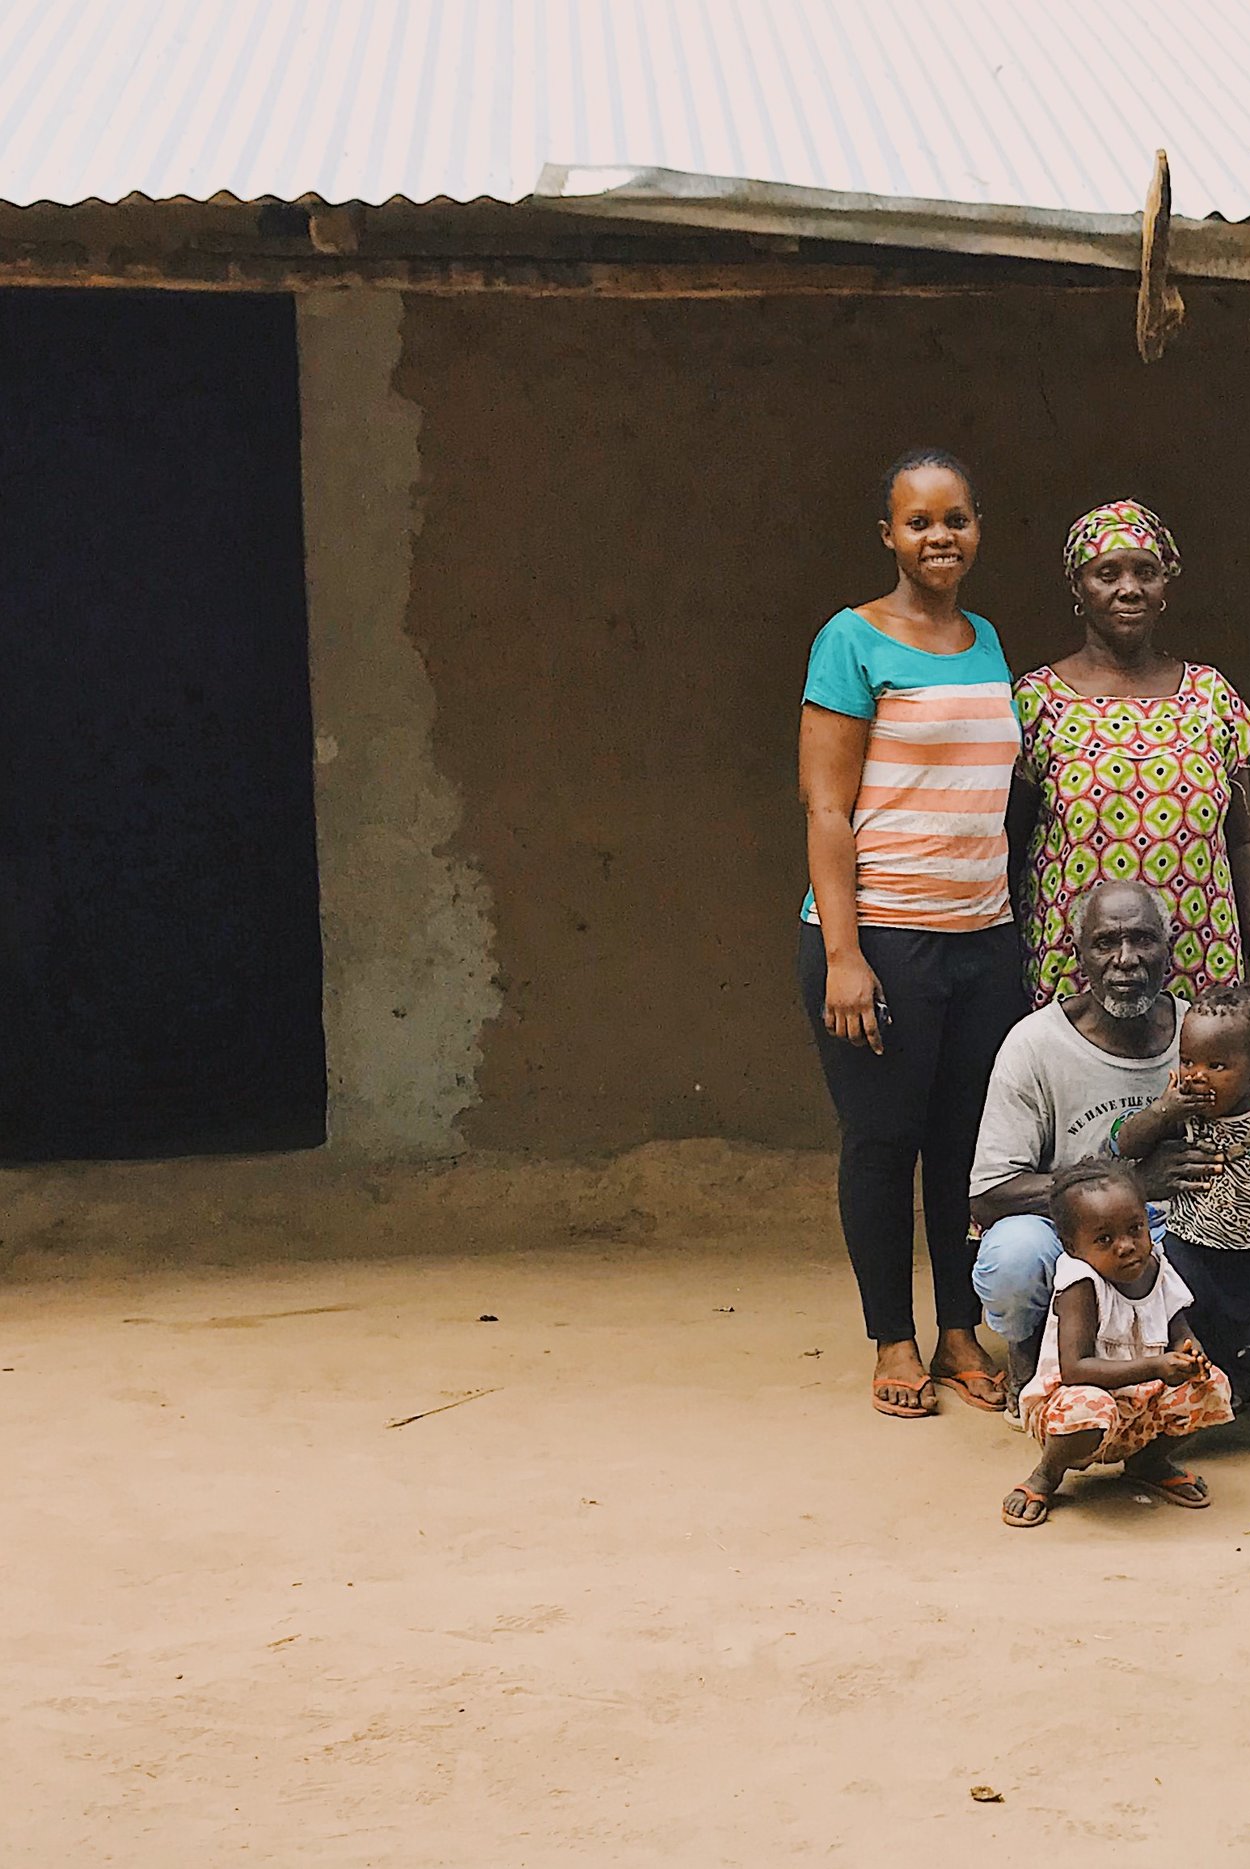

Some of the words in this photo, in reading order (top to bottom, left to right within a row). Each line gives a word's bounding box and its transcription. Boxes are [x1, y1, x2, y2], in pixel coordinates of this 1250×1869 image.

[1067, 1118, 1086, 1136] WE
[1084, 1099, 1118, 1121] HAVE
[1118, 1096, 1144, 1108] THE
